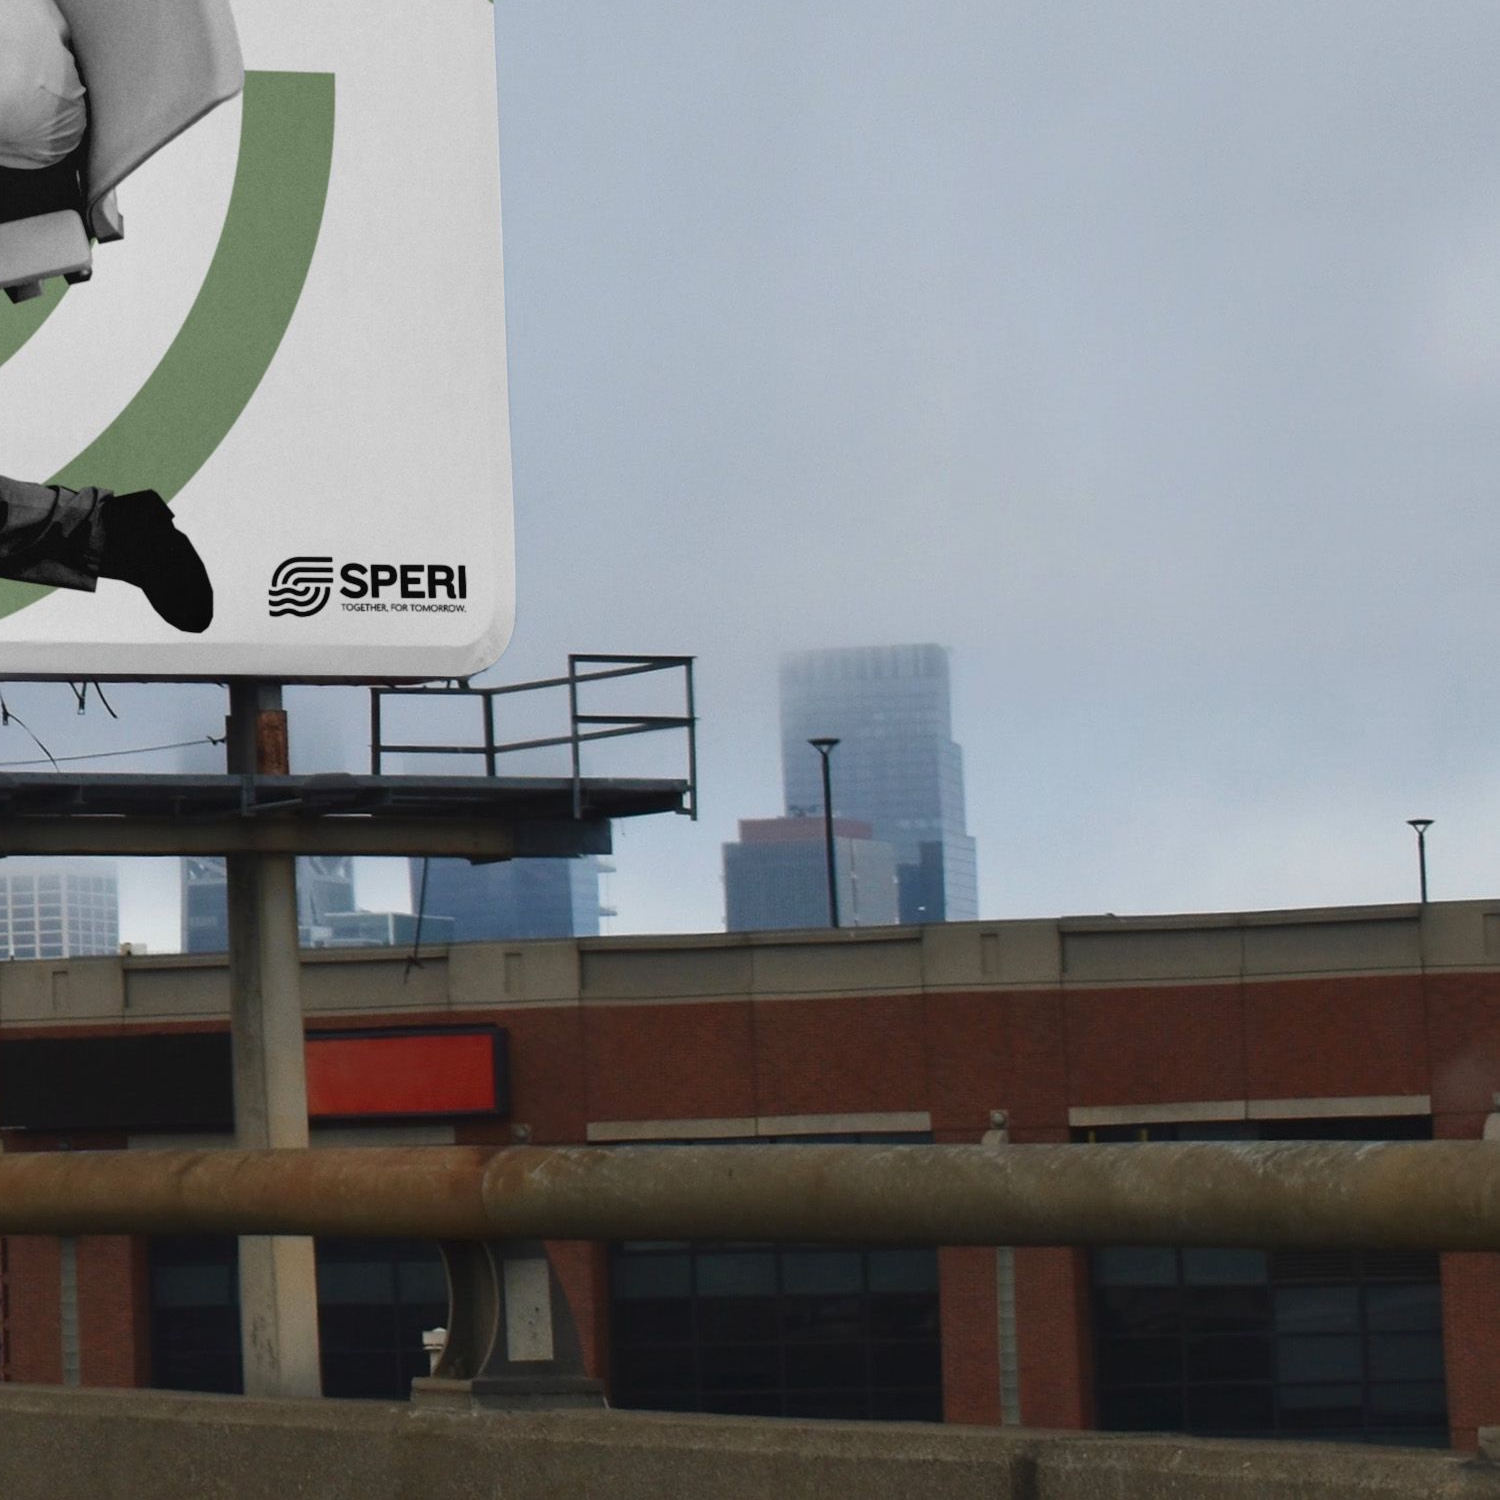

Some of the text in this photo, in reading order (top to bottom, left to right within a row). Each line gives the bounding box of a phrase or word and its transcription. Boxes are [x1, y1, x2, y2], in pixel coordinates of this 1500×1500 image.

[339, 562, 467, 600] SPERI
[341, 602, 467, 613] TOGETHER, FOR TOMORROW.
